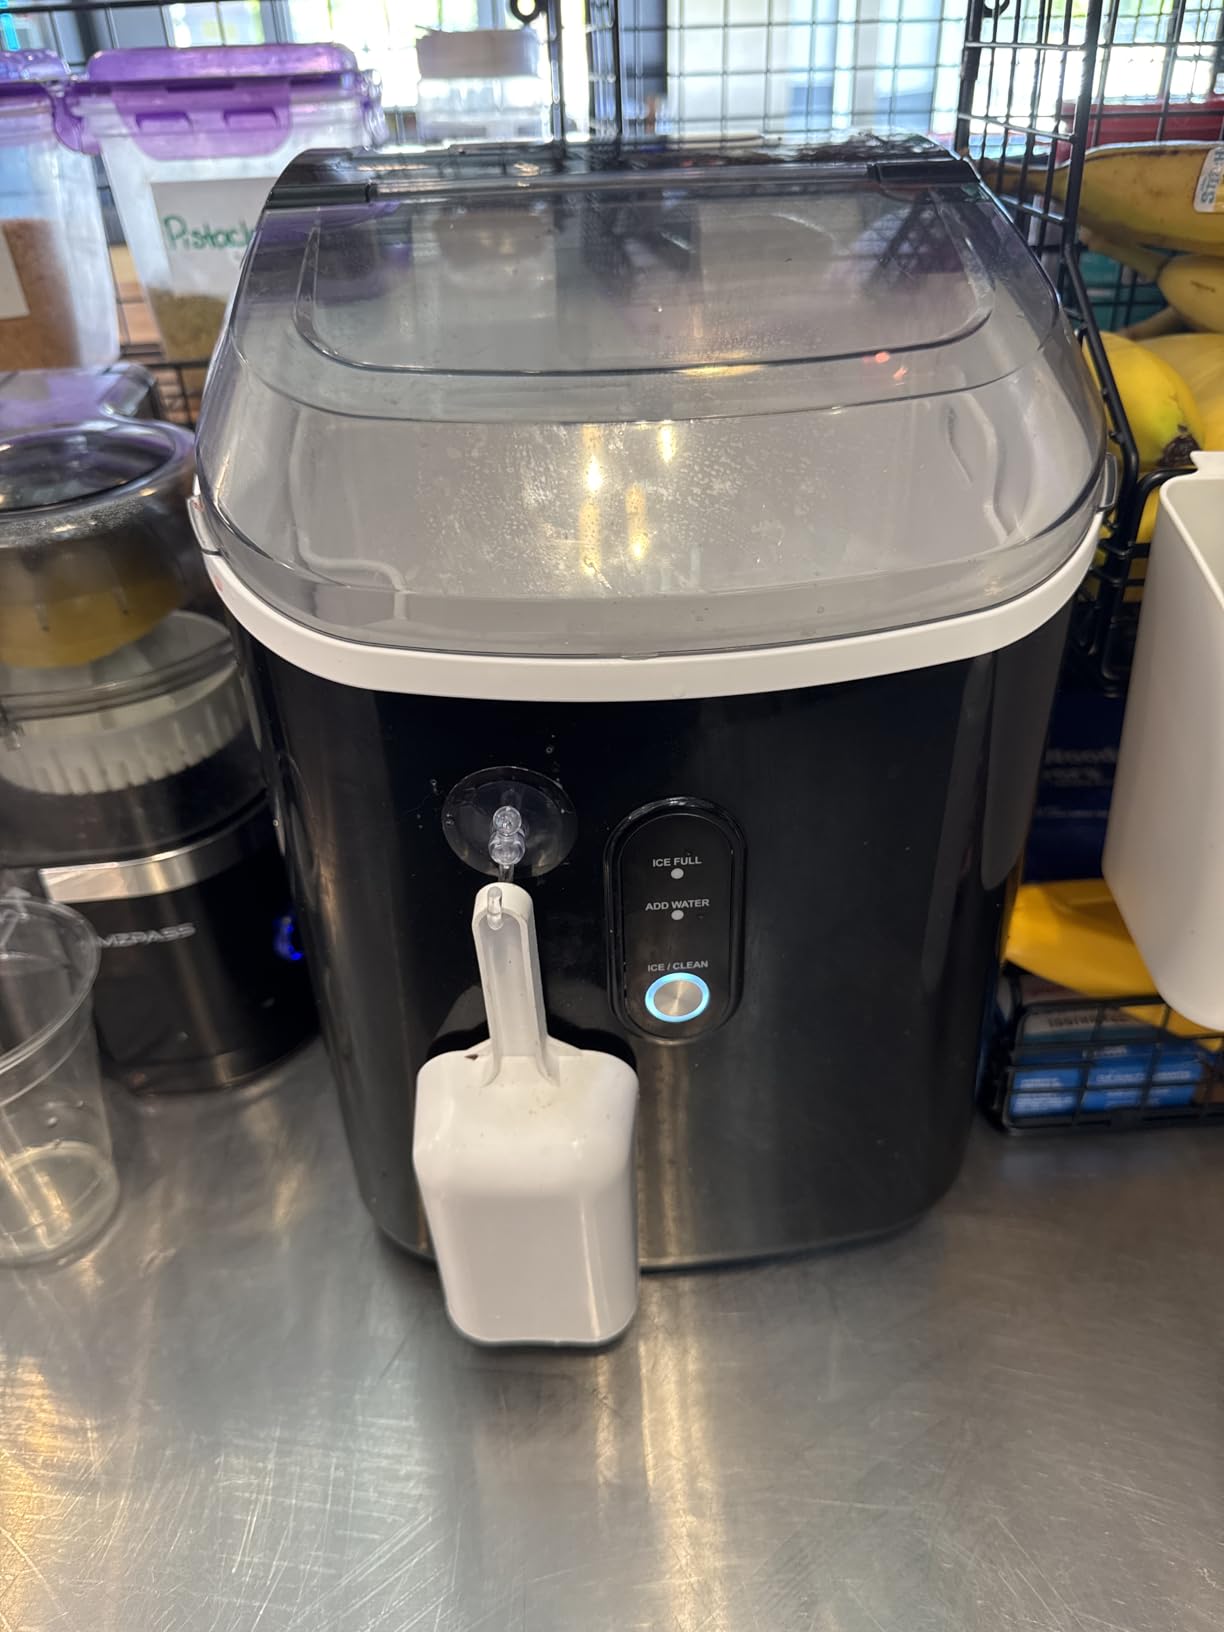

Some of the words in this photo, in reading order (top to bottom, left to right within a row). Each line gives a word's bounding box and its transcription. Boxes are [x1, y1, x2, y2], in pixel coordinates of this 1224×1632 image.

[652, 858, 671, 867] ICE
[673, 856, 702, 866] FULL
[645, 901, 669, 911] ADD
[671, 899, 710, 909] WATER
[647, 963, 665, 972] ICE
[672, 960, 709, 970] CLEAN
